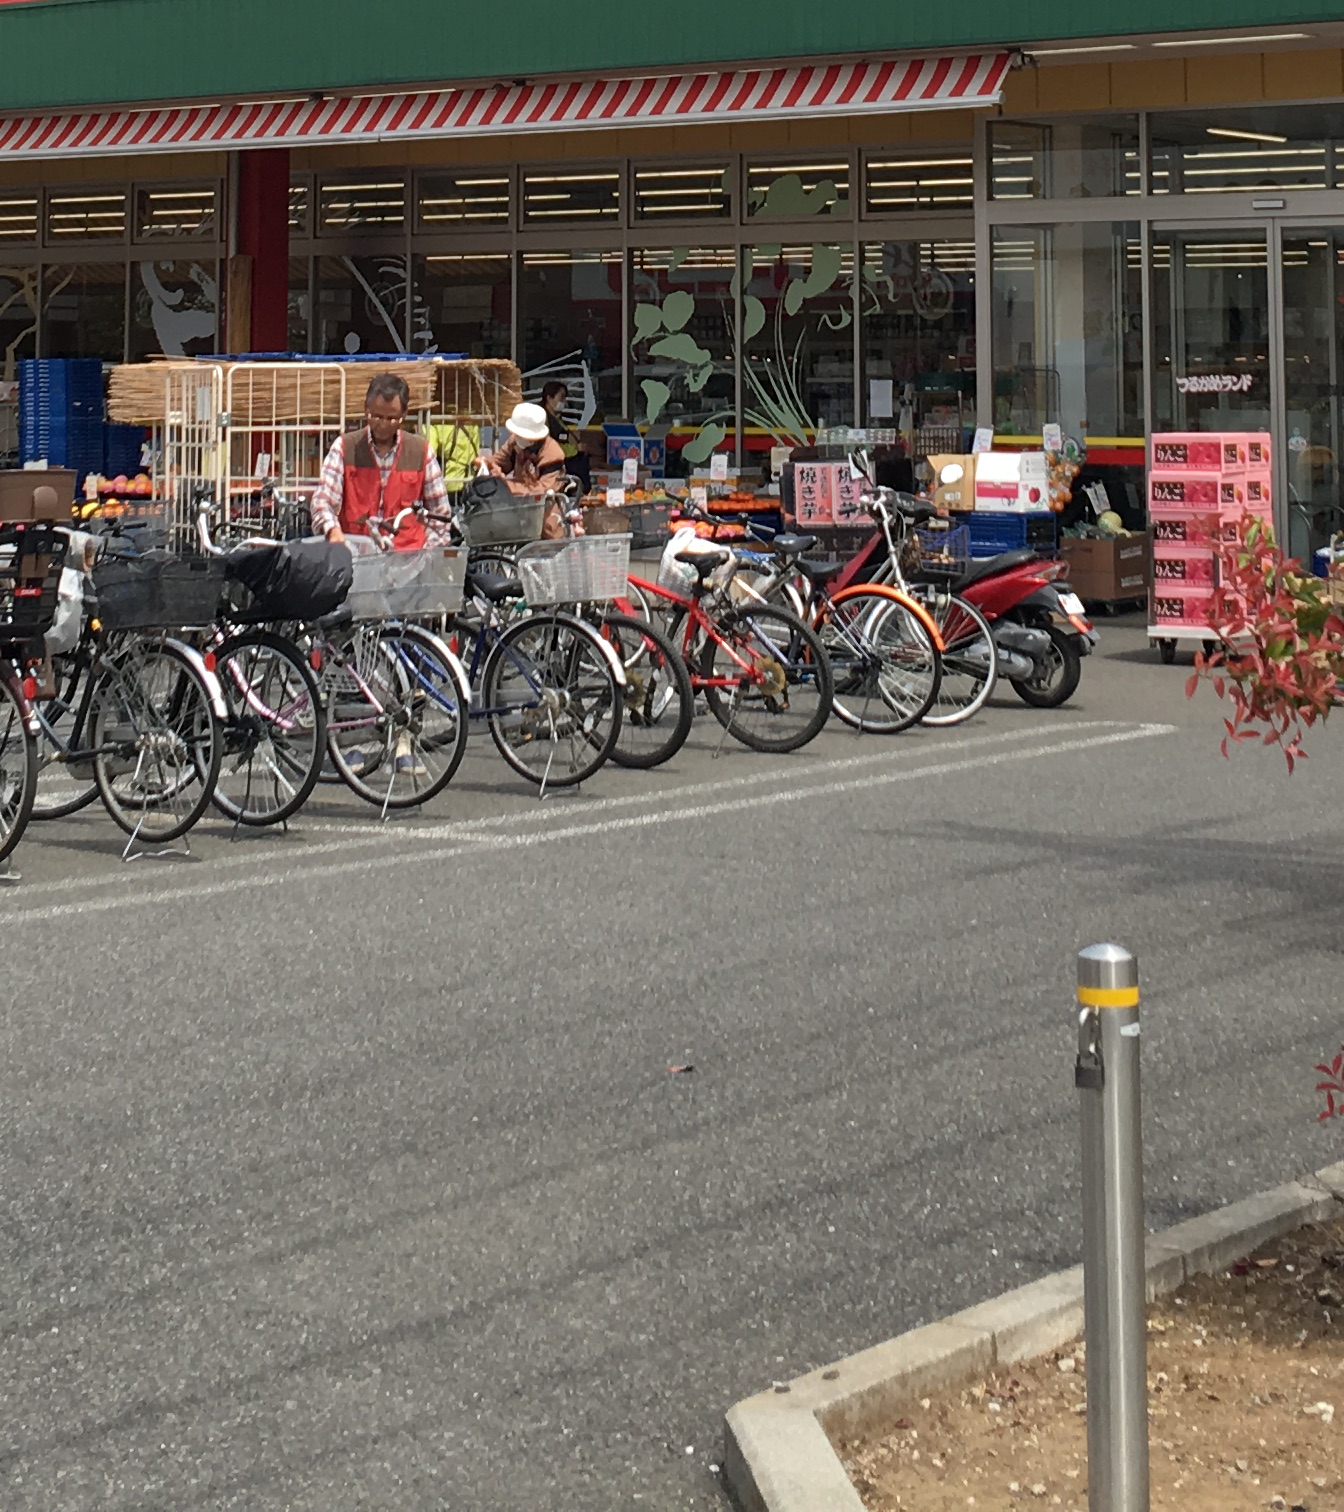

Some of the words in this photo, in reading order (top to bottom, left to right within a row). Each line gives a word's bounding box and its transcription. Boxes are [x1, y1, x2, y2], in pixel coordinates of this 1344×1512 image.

[1176, 374, 1253, 393] つるかめランド
[799, 467, 817, 520] 焼き芋
